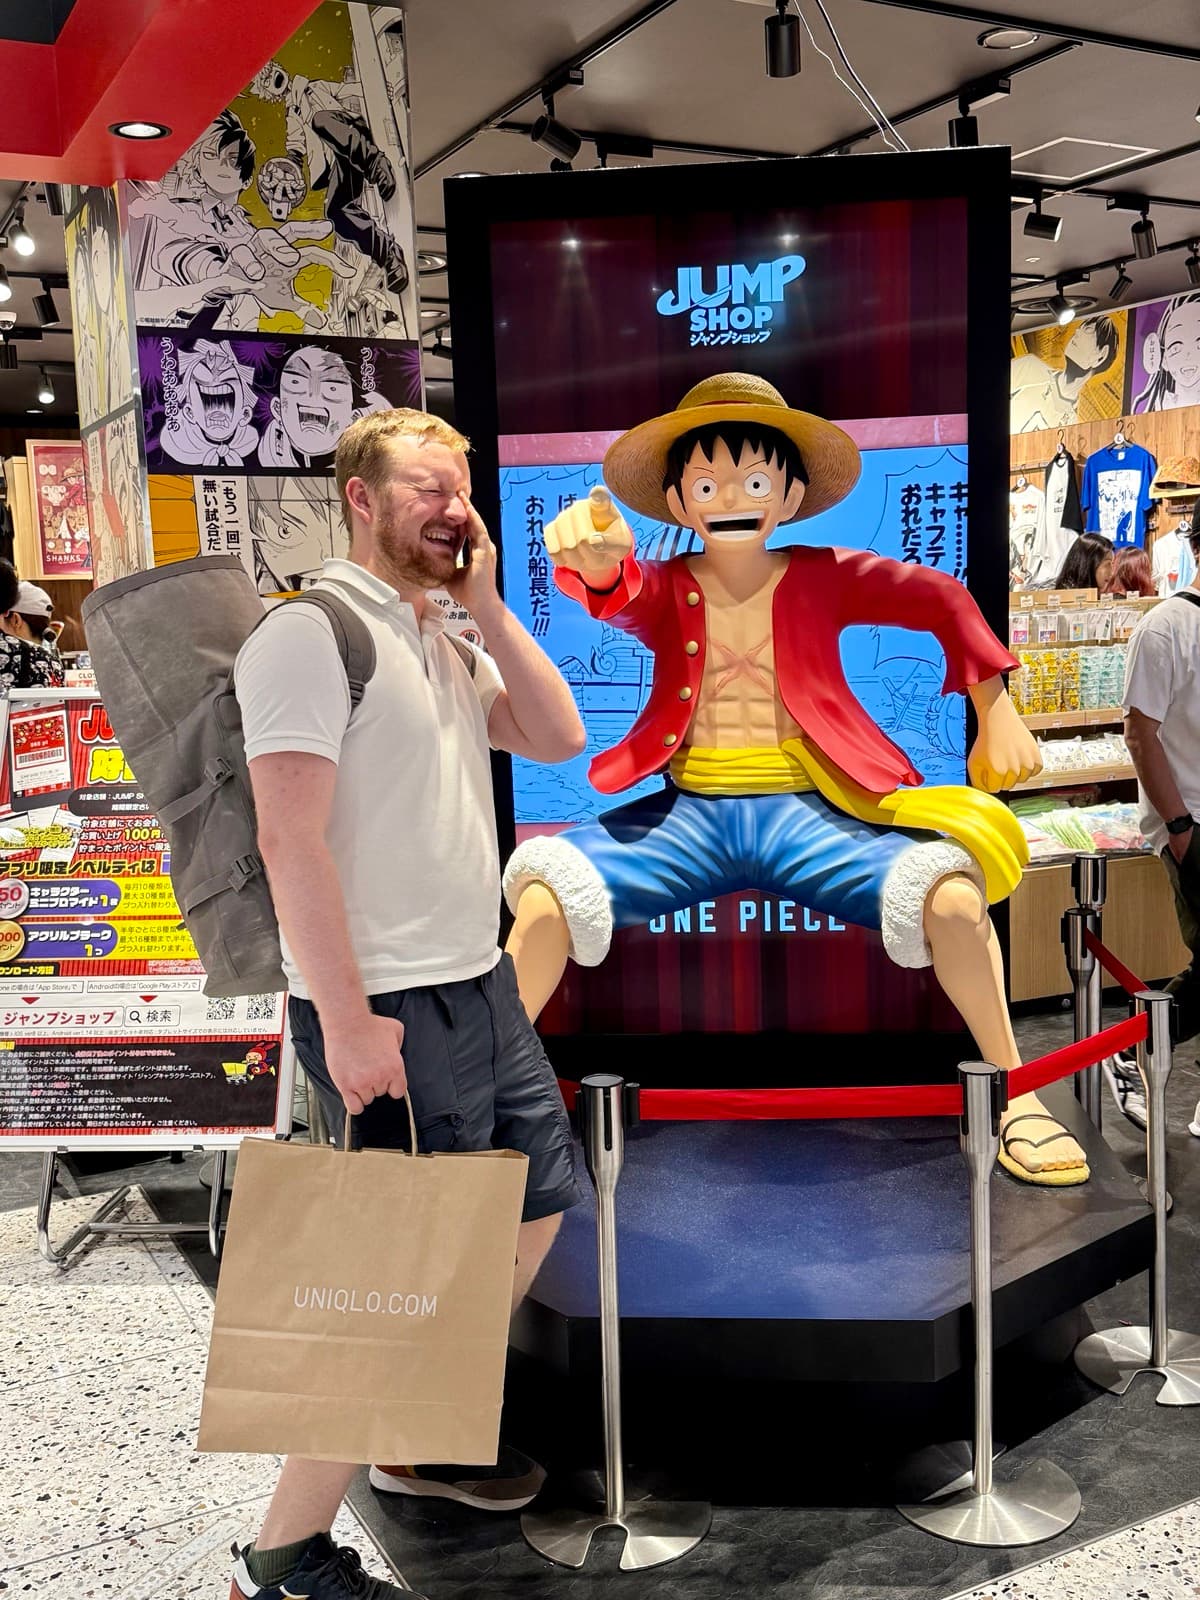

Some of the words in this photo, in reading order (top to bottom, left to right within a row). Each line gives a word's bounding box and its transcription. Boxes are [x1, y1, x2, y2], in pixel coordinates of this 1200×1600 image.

[657, 255, 806, 316] JUMP
[690, 305, 773, 332] SHOP
[690, 331, 772, 347] ジャンプショップ
[203, 479, 222, 551] 無い試合だ
[46, 554, 81, 562] SHANKS
[30, 886, 90, 897] キャラクター
[650, 901, 717, 933] ONE
[4, 1010, 117, 1026] ジャンプショップ
[146, 1010, 172, 1023] 検索
[294, 1286, 437, 1318] UNIQLO.COM
